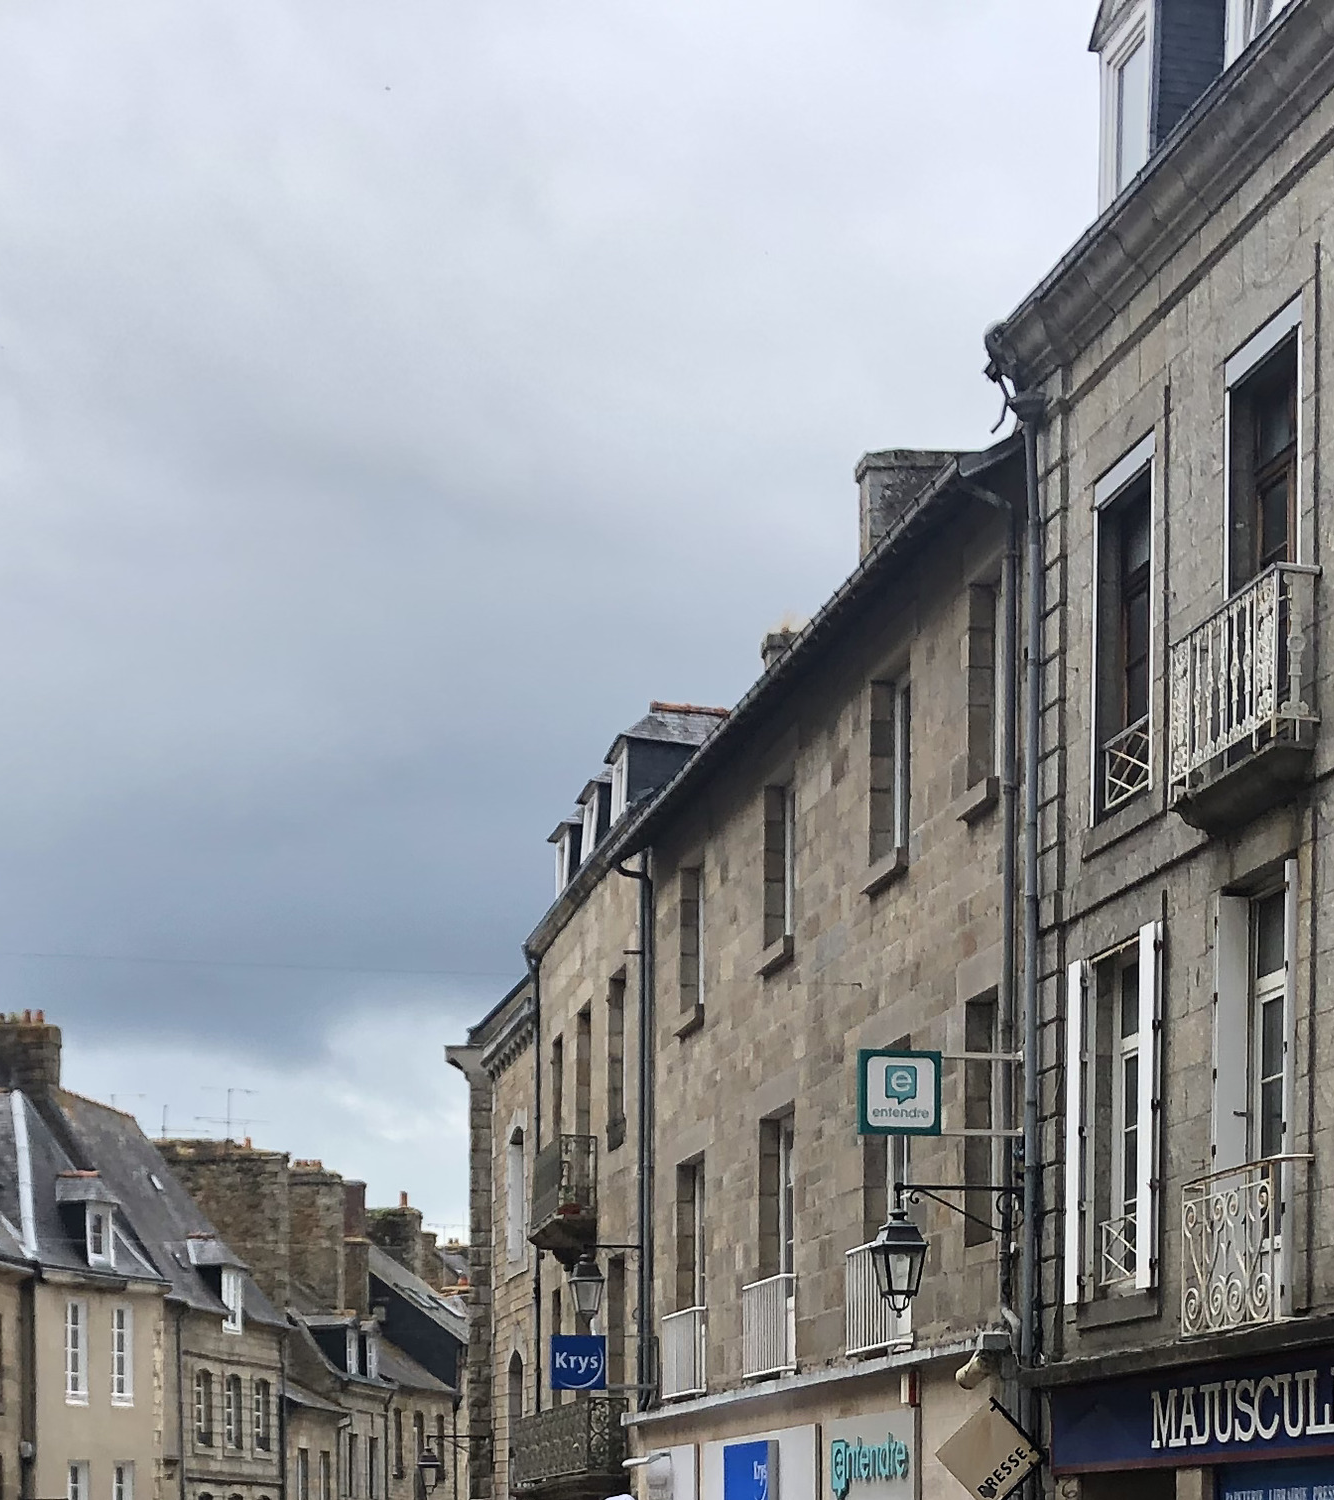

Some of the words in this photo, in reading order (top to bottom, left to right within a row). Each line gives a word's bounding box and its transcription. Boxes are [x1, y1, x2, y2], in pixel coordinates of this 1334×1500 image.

[872, 1107, 930, 1119] entendre
[555, 1351, 598, 1374] Krys
[833, 1432, 907, 1481] entendre
[976, 1446, 1028, 1500] PRESSE
